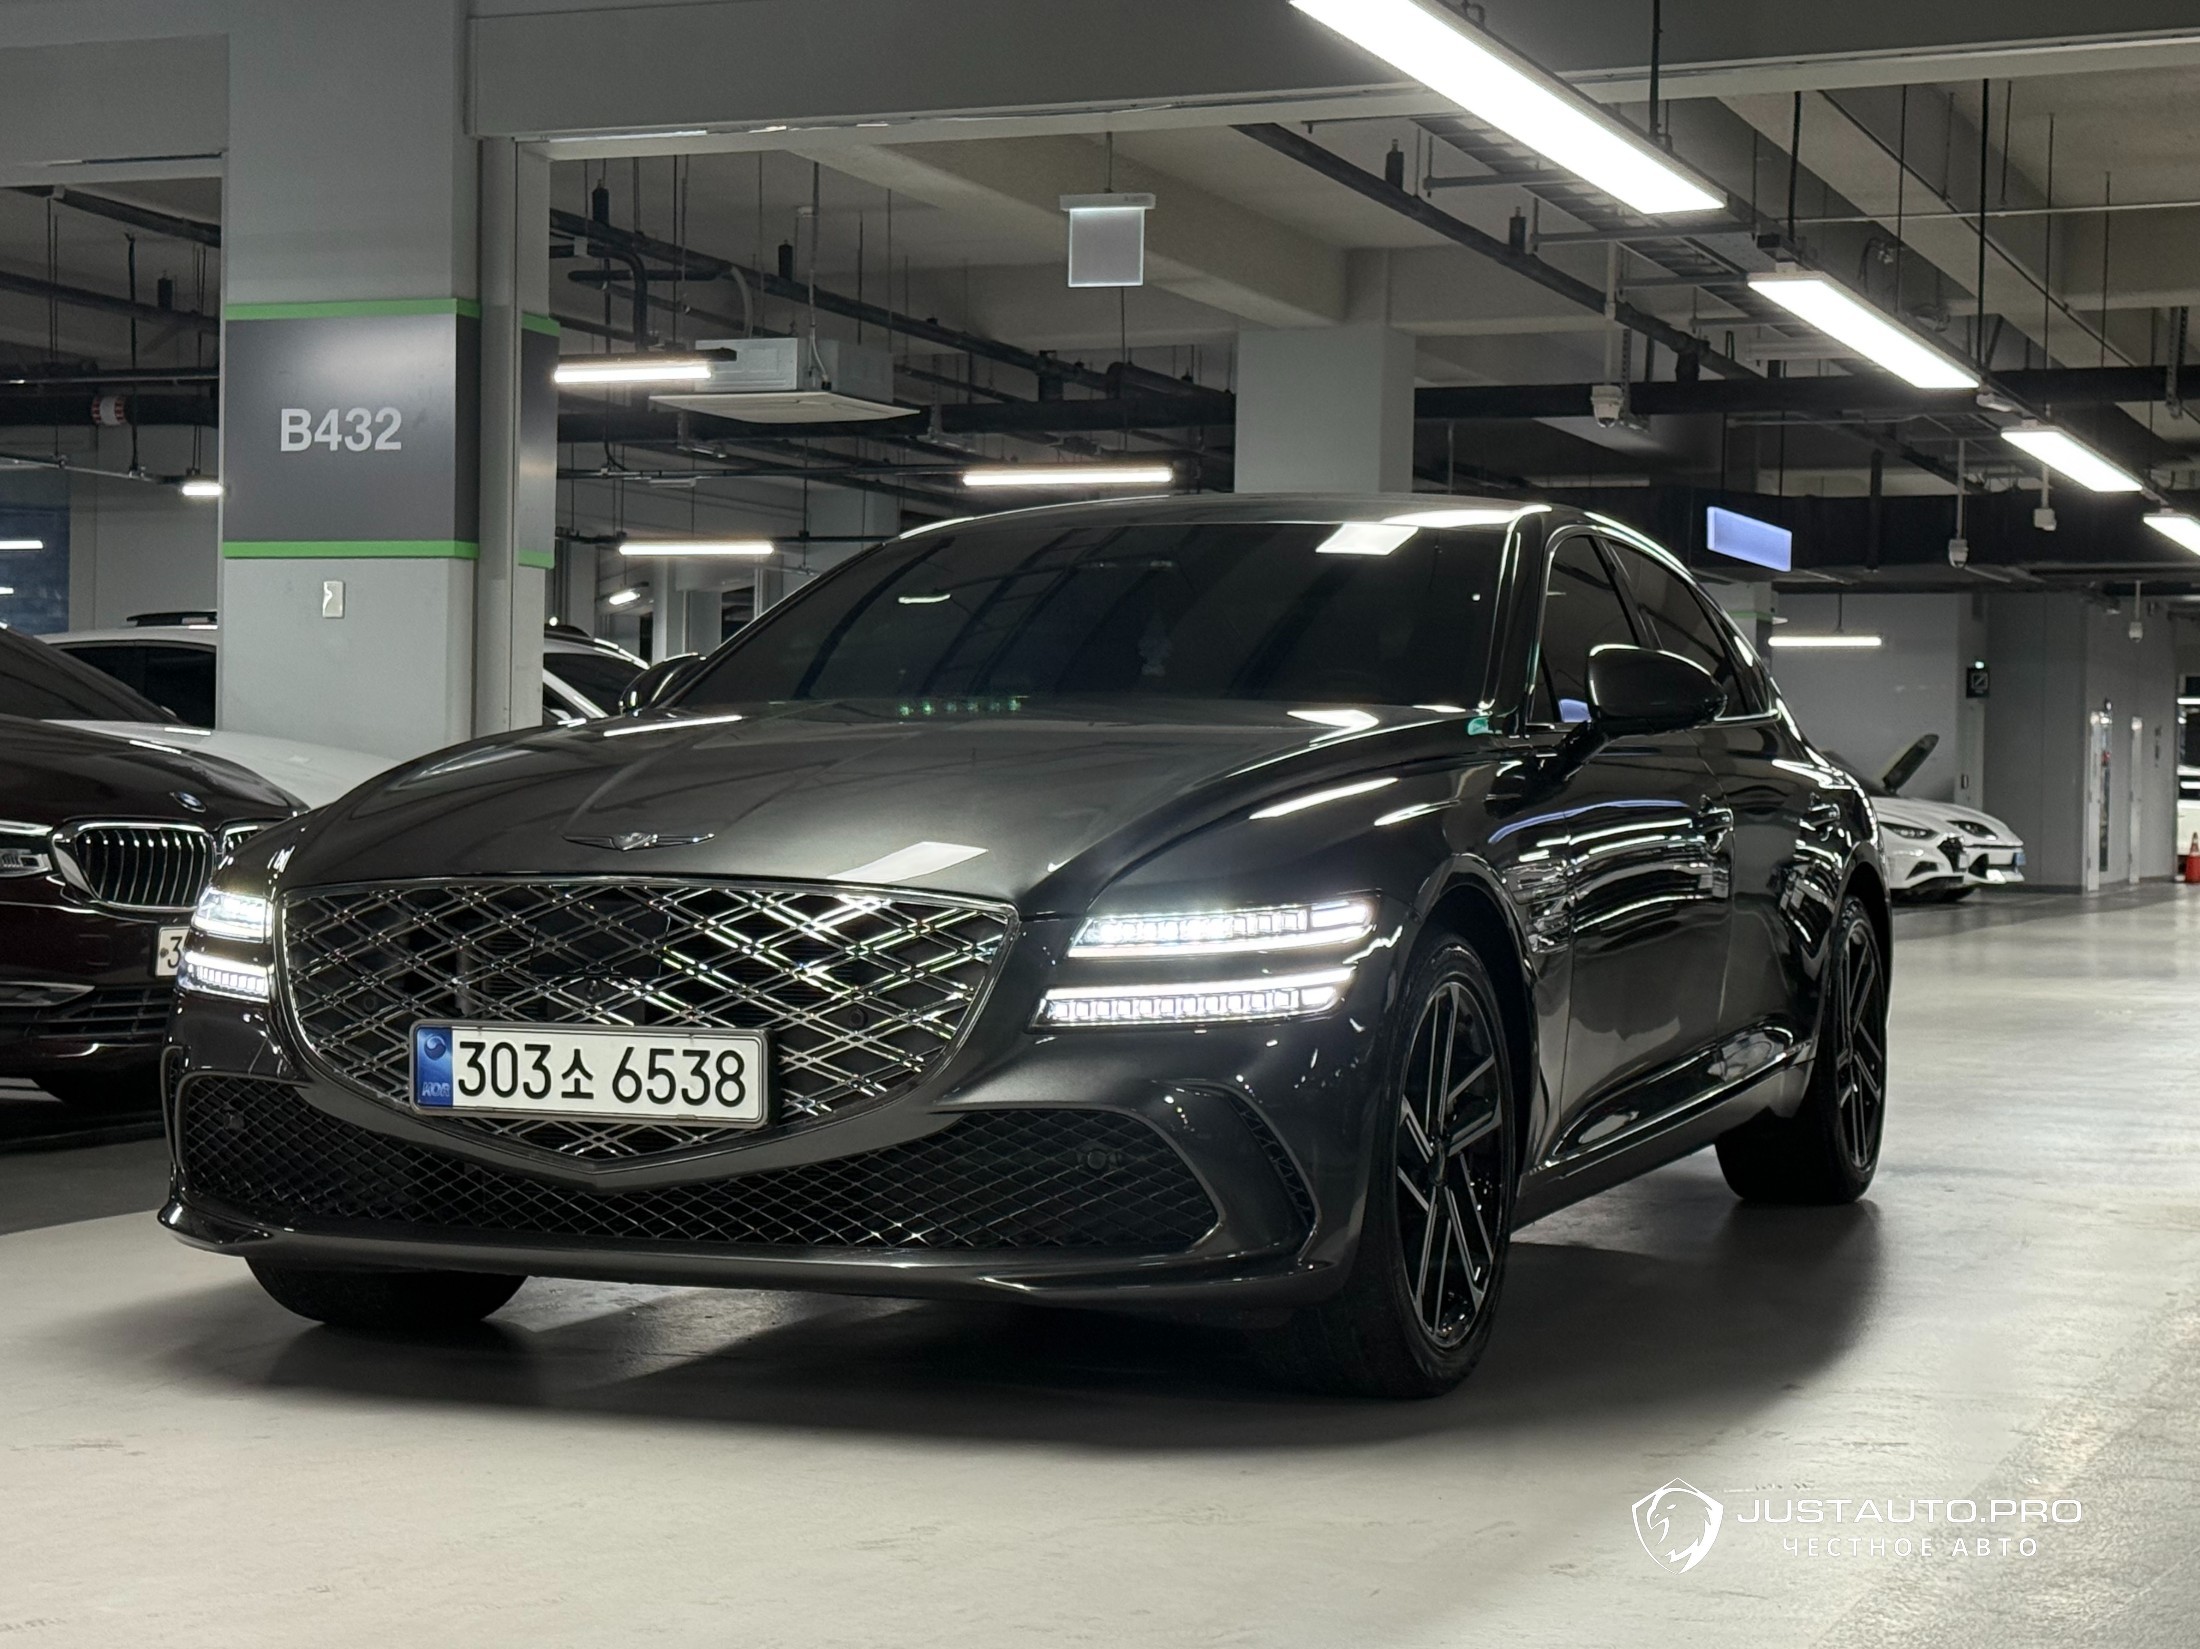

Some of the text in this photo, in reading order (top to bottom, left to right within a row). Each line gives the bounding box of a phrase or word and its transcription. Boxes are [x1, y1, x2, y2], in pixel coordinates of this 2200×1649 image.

[280, 407, 402, 452] B432
[421, 1081, 451, 1097] KOR
[458, 1041, 746, 1107] 303소 6538
